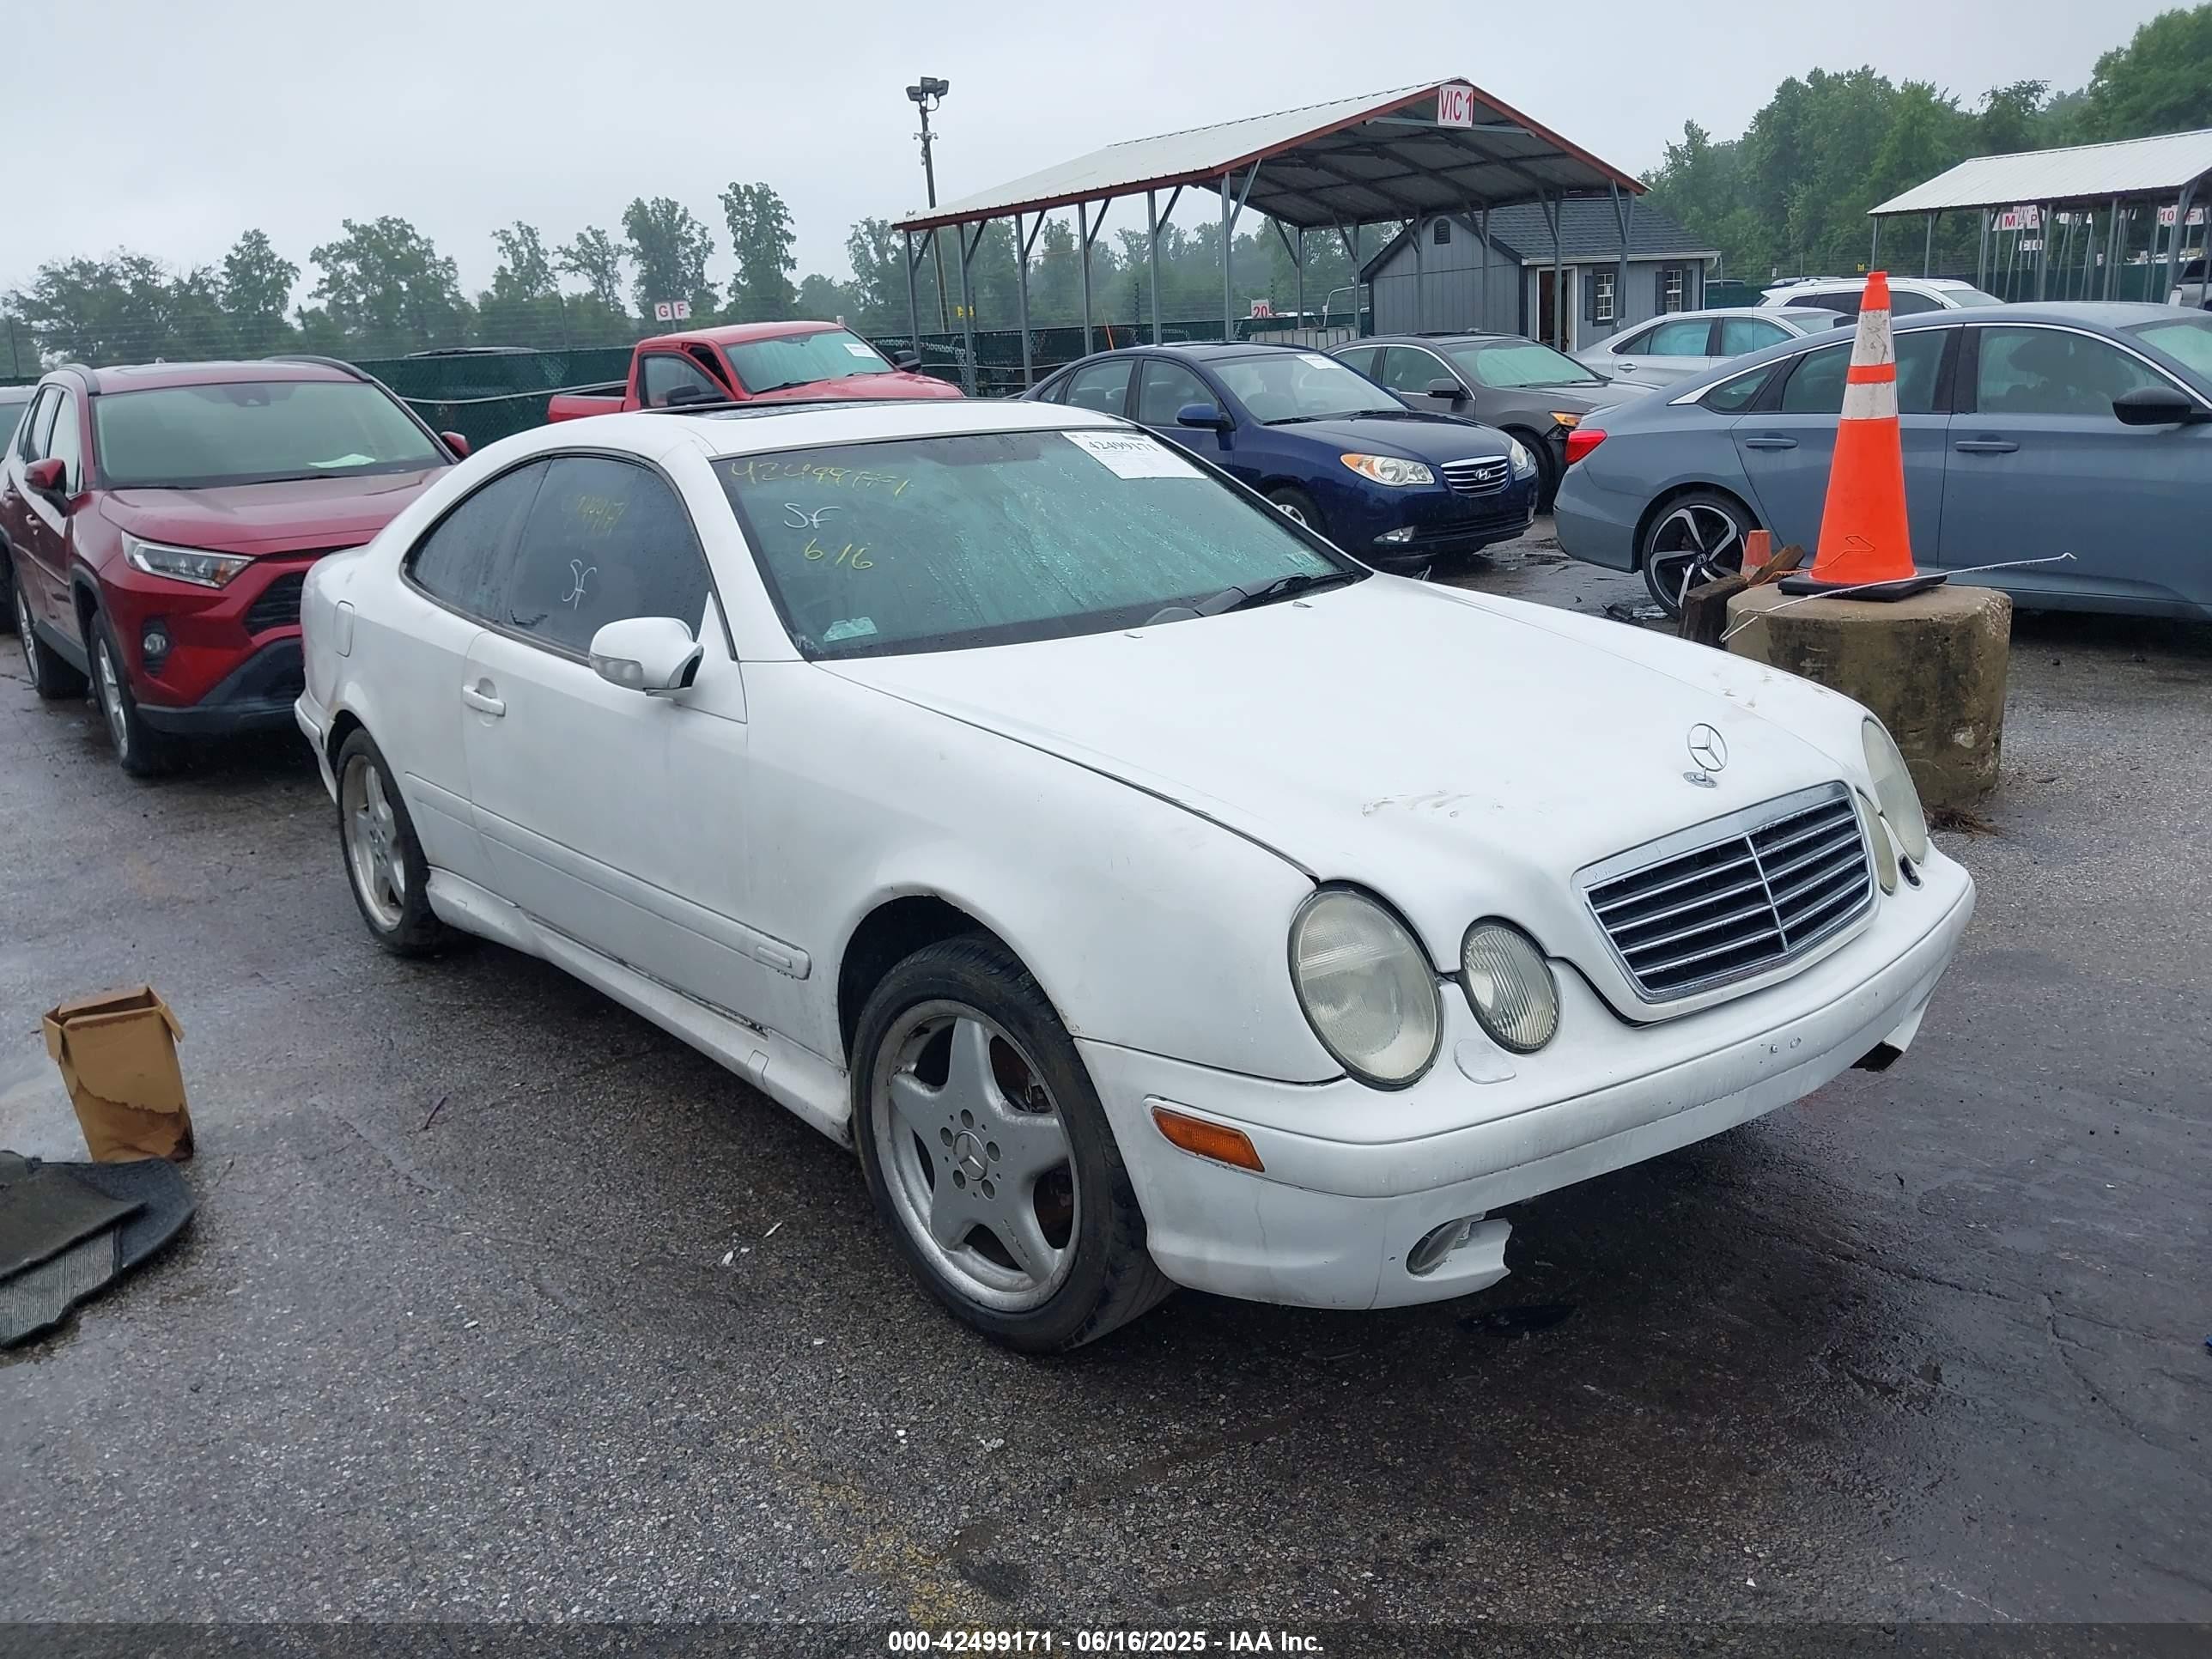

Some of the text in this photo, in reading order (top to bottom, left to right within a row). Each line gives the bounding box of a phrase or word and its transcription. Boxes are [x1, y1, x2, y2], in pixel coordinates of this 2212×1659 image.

[1441, 89, 1472, 121] VIC 1
[1253, 306, 1267, 319] 20
[1089, 441, 1159, 452] 42499171
